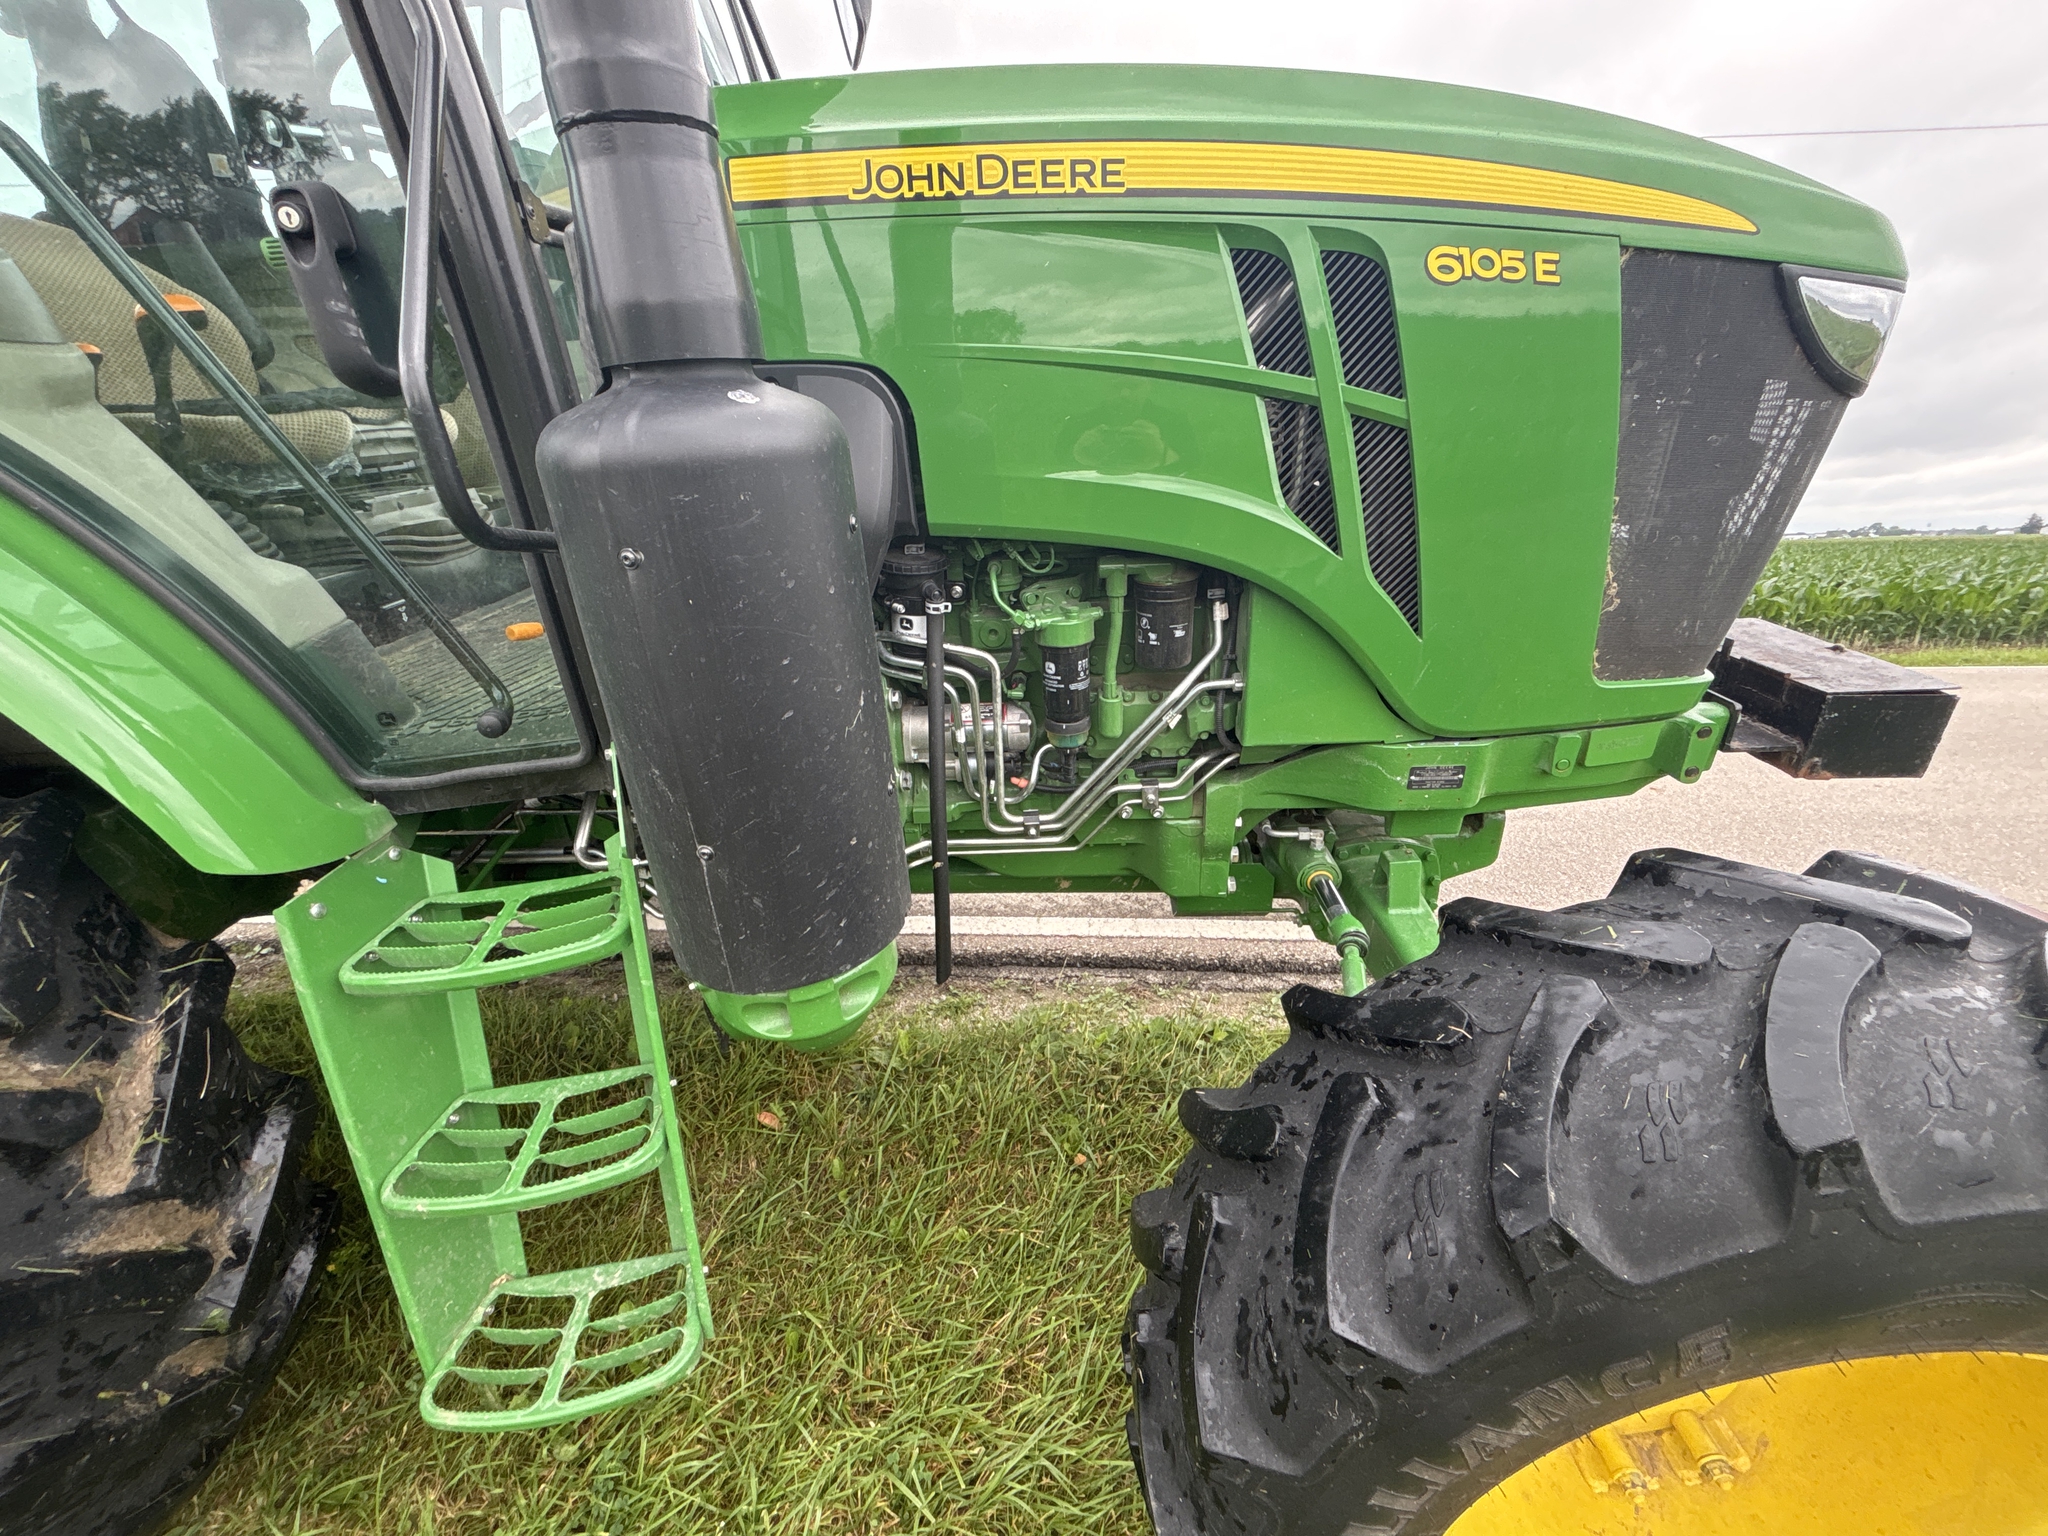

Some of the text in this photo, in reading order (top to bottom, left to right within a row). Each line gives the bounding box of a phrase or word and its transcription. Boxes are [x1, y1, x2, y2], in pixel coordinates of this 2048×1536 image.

[851, 153, 1126, 195] JOHN DEERE
[1425, 245, 1561, 286] 6105 E
